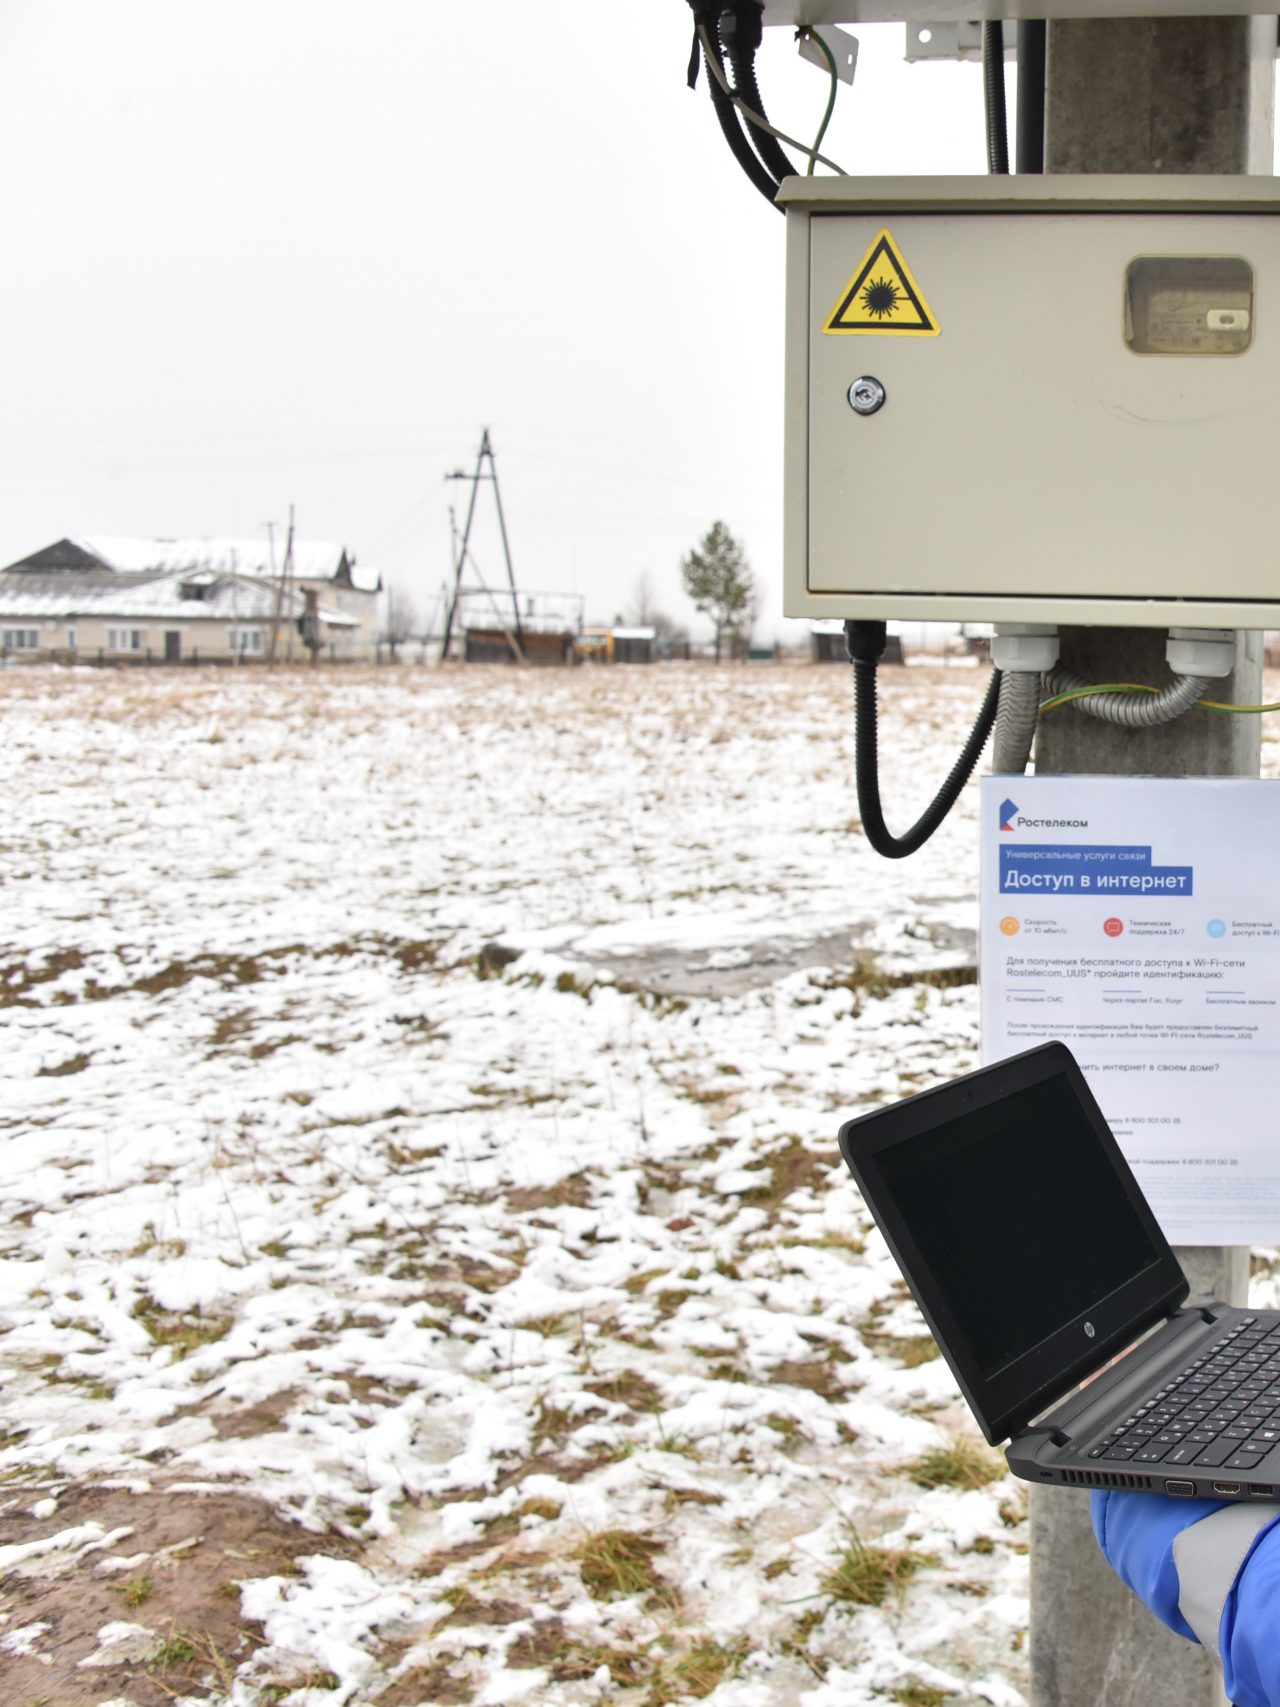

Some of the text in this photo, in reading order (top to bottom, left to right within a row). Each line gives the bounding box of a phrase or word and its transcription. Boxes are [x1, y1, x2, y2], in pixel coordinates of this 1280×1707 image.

[1017, 817, 1088, 828] Ростелеком
[1006, 850, 1146, 861] Универсальные услуги связи
[1005, 870, 1186, 891] Доступ в интернет
[1024, 919, 1057, 927] Скорость
[1006, 957, 1024, 967] Для
[1027, 958, 1077, 968] получения
[1080, 958, 1142, 967] бесплатного
[1144, 959, 1183, 968] доступа
[1193, 958, 1245, 968] Wi-Fi-сети
[1094, 969, 1140, 979] пройдите
[1143, 970, 1224, 980] идентификацию:
[1103, 1063, 1146, 1073] интернет
[1149, 1064, 1155, 1072] в
[1157, 1064, 1187, 1072] своем
[1189, 1063, 1220, 1073] доме?
